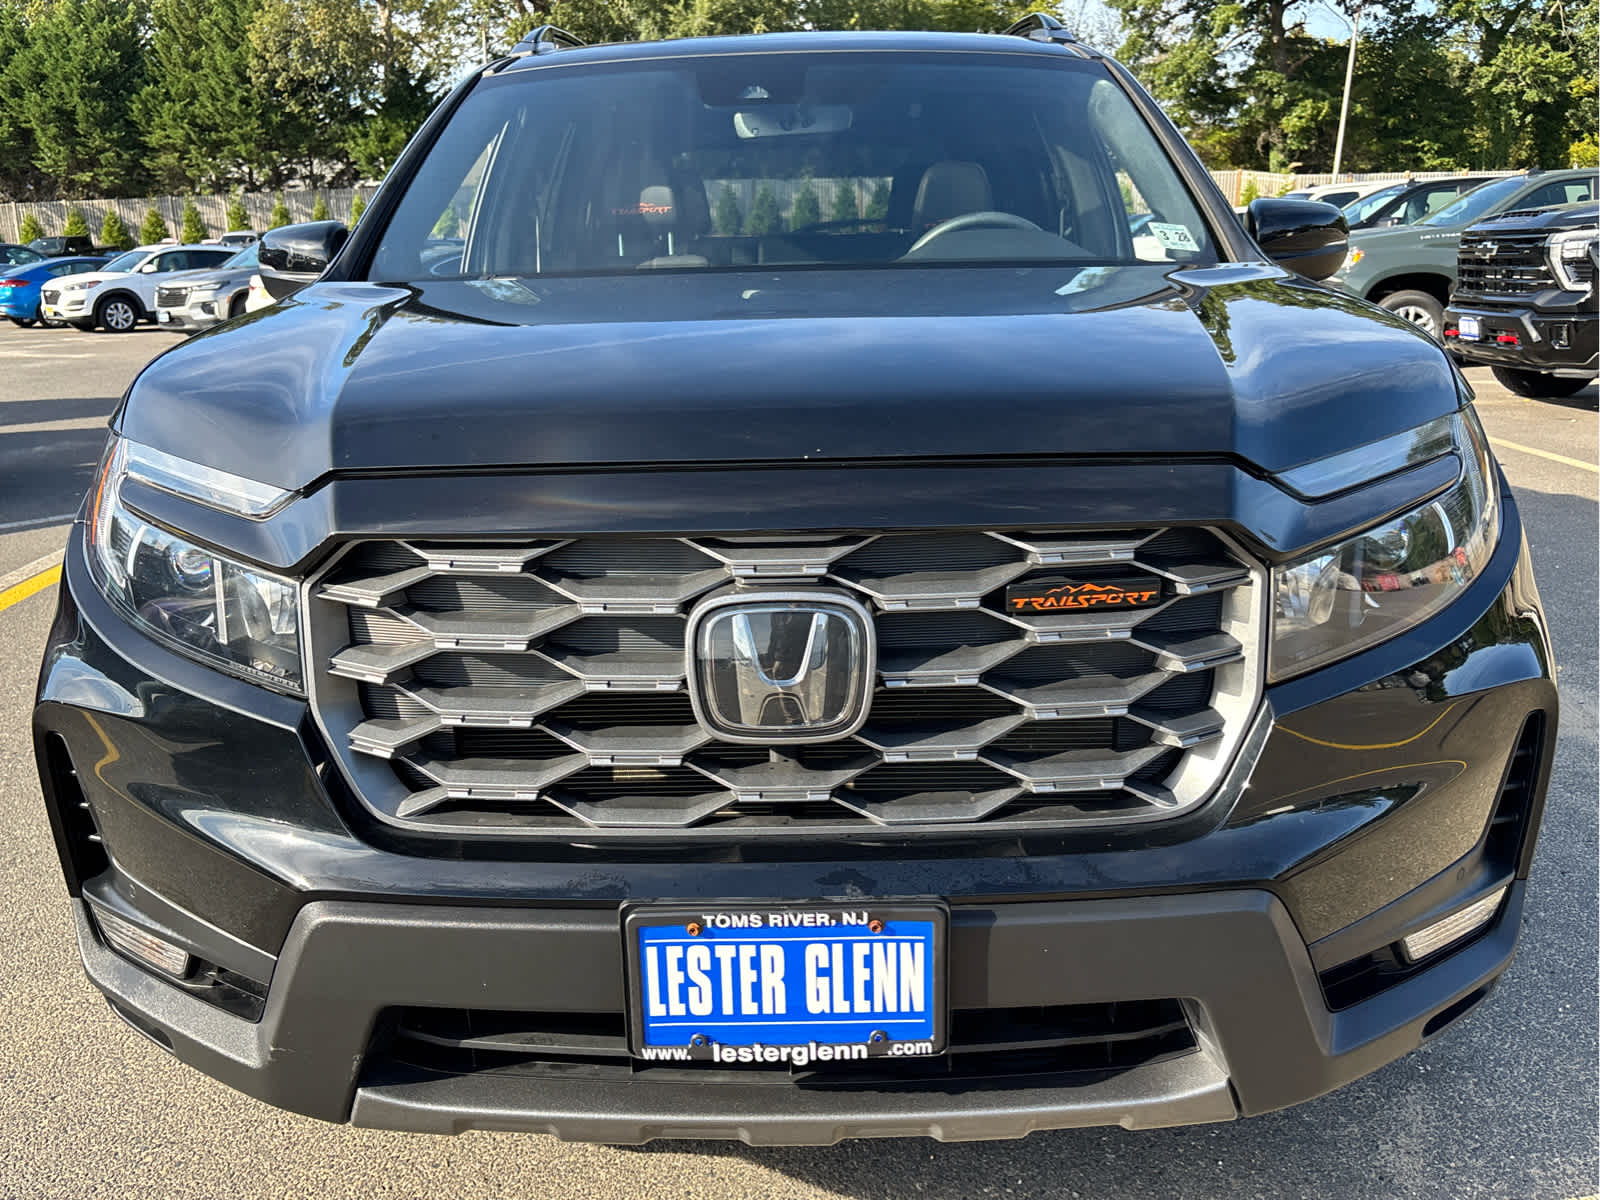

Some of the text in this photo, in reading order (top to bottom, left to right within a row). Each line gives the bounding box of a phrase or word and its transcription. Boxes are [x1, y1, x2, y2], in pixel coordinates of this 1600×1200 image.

[1011, 591, 1157, 610] TRAILSPORT
[702, 911, 869, 928] TOMS RIVER, NJ
[646, 942, 924, 1017] LESTER GLENN
[641, 1041, 932, 1066] www. lesterglenn .com
